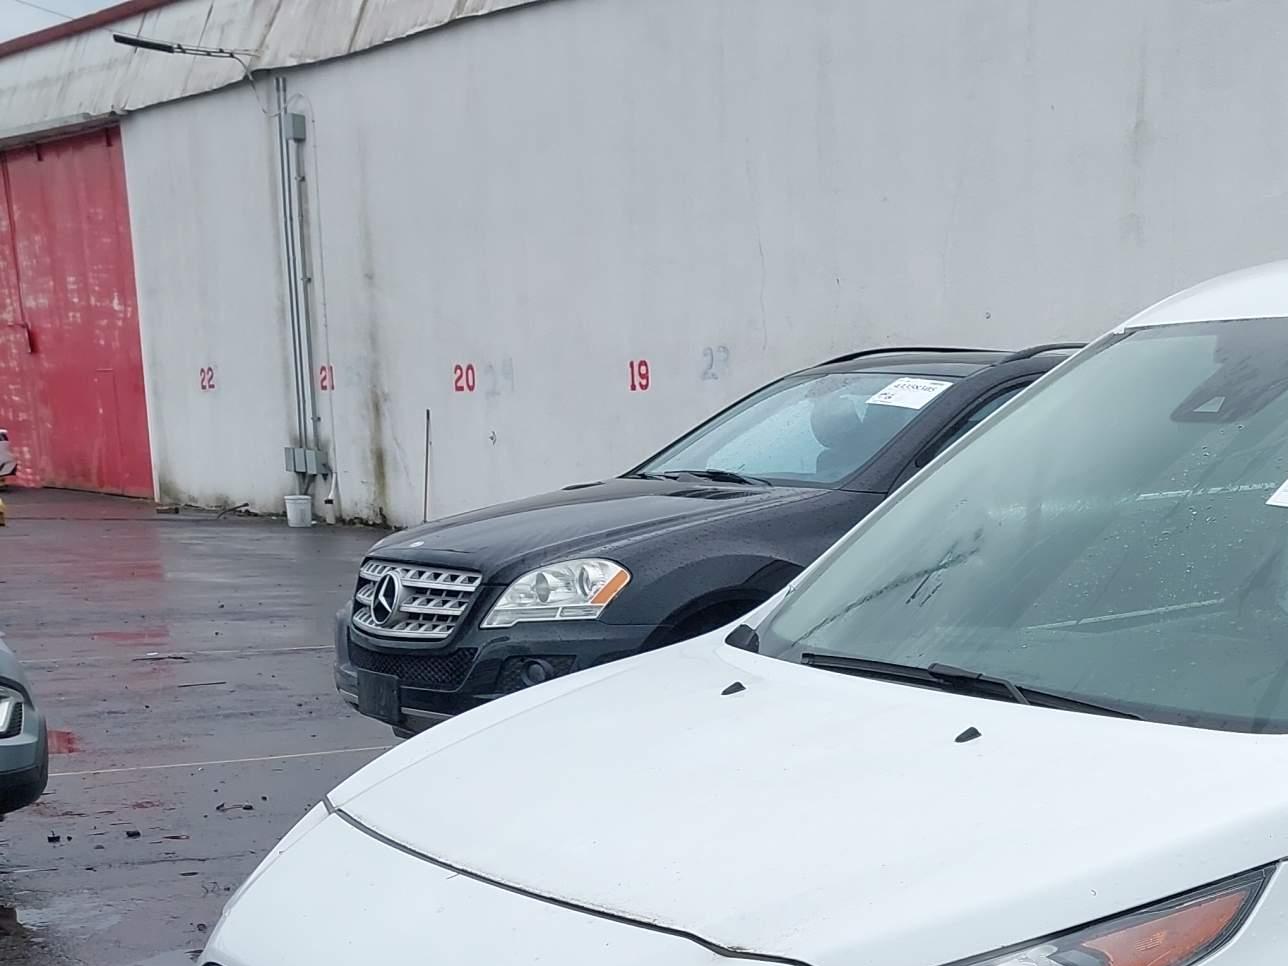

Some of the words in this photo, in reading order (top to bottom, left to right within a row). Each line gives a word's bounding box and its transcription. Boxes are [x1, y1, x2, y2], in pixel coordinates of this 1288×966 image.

[199, 366, 216, 390] 22
[319, 365, 335, 391] 21
[454, 363, 476, 392] 20
[629, 359, 650, 391] 19
